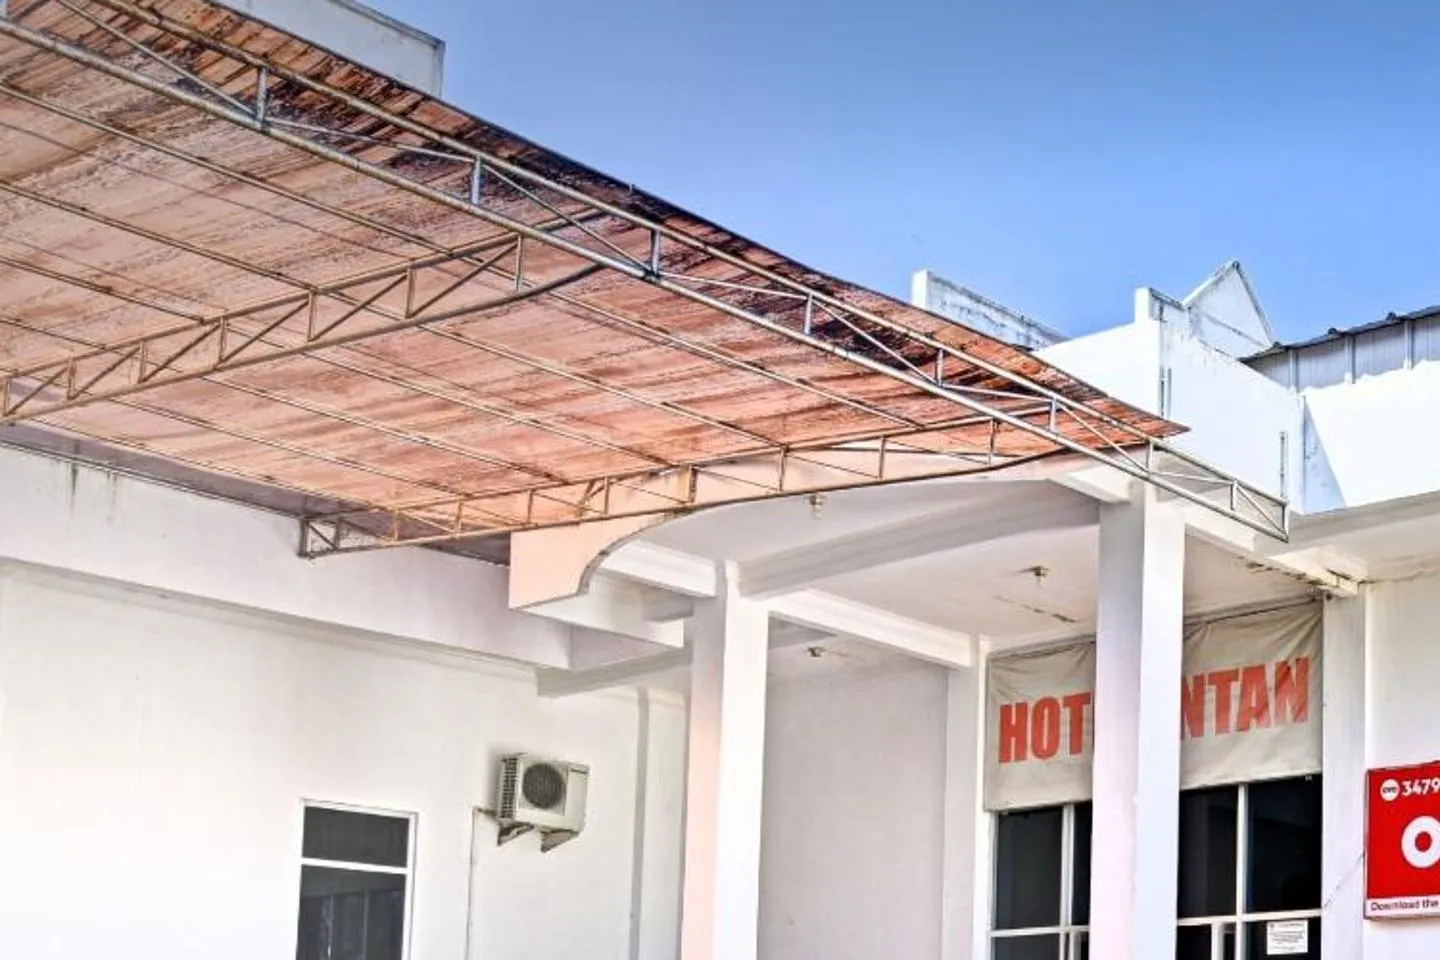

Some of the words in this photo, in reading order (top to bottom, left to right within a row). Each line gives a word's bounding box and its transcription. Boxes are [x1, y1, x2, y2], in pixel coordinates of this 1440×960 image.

[999, 691, 1095, 763] HOT
[1181, 656, 1309, 738] NTAN
[1402, 777, 1440, 796] 3479
[1422, 898, 1439, 908] the
